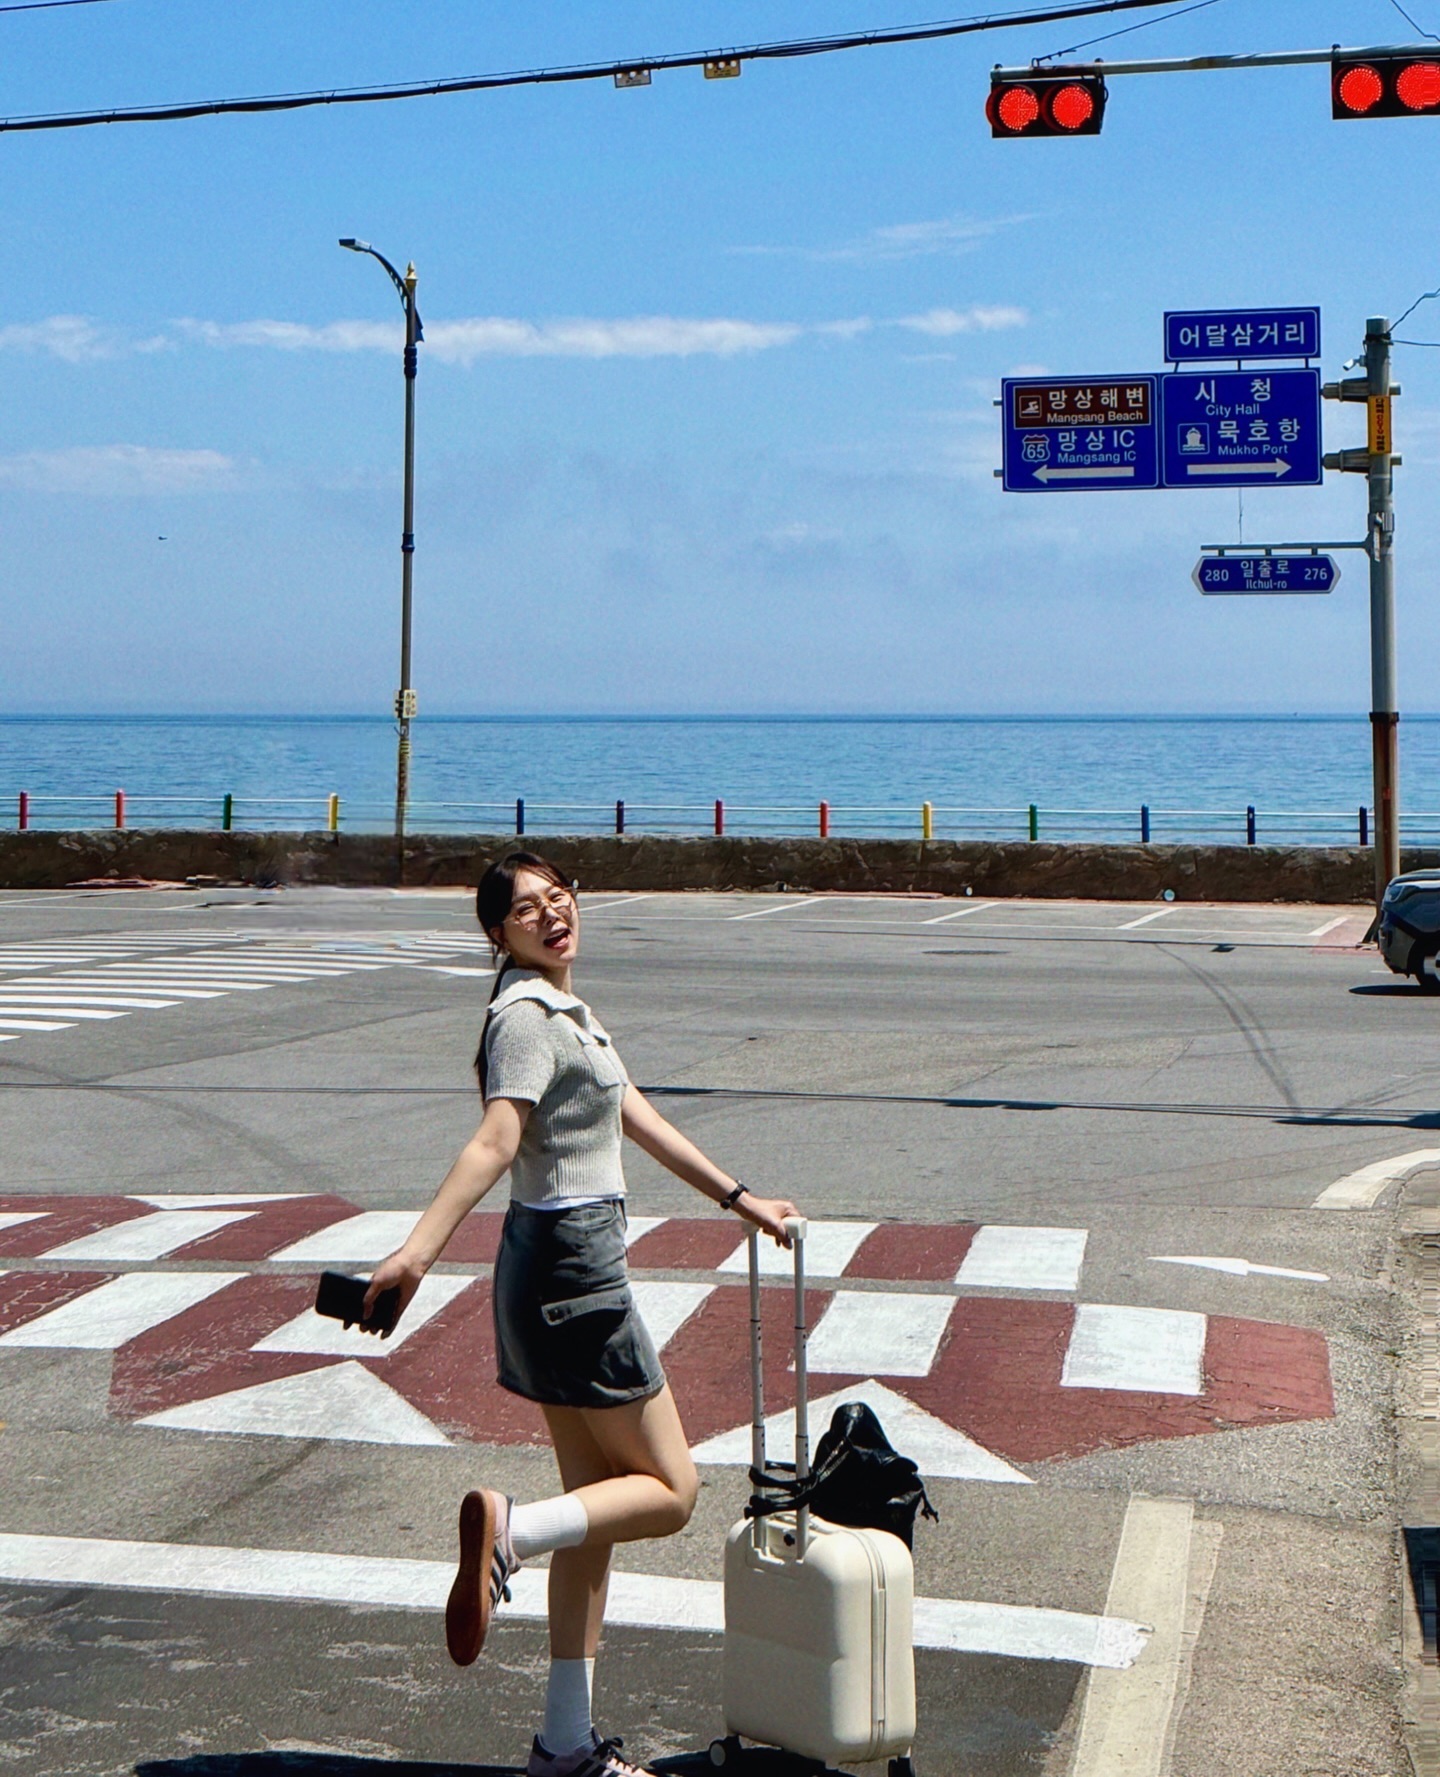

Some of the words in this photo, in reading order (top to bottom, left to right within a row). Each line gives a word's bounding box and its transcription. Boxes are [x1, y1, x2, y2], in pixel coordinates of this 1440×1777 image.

[1179, 321, 1305, 348] 어달삼거리
[1049, 386, 1144, 410] 망상해변
[1047, 412, 1105, 425] Mangsang
[1108, 410, 1143, 421] Beach
[1205, 404, 1231, 418] City
[1235, 403, 1260, 415] Hall
[1217, 418, 1301, 443] 묵호항
[1113, 429, 1135, 448] IC
[1026, 444, 1046, 459] 65
[1218, 444, 1259, 455] Mukho
[1263, 444, 1288, 454] Port
[1058, 452, 1120, 465] Mangsang
[1124, 450, 1137, 462] IC
[1205, 569, 1229, 582] 280
[1240, 559, 1291, 578] 일출로
[1304, 568, 1328, 580] 276
[1246, 579, 1287, 589] Ilchul-ro
